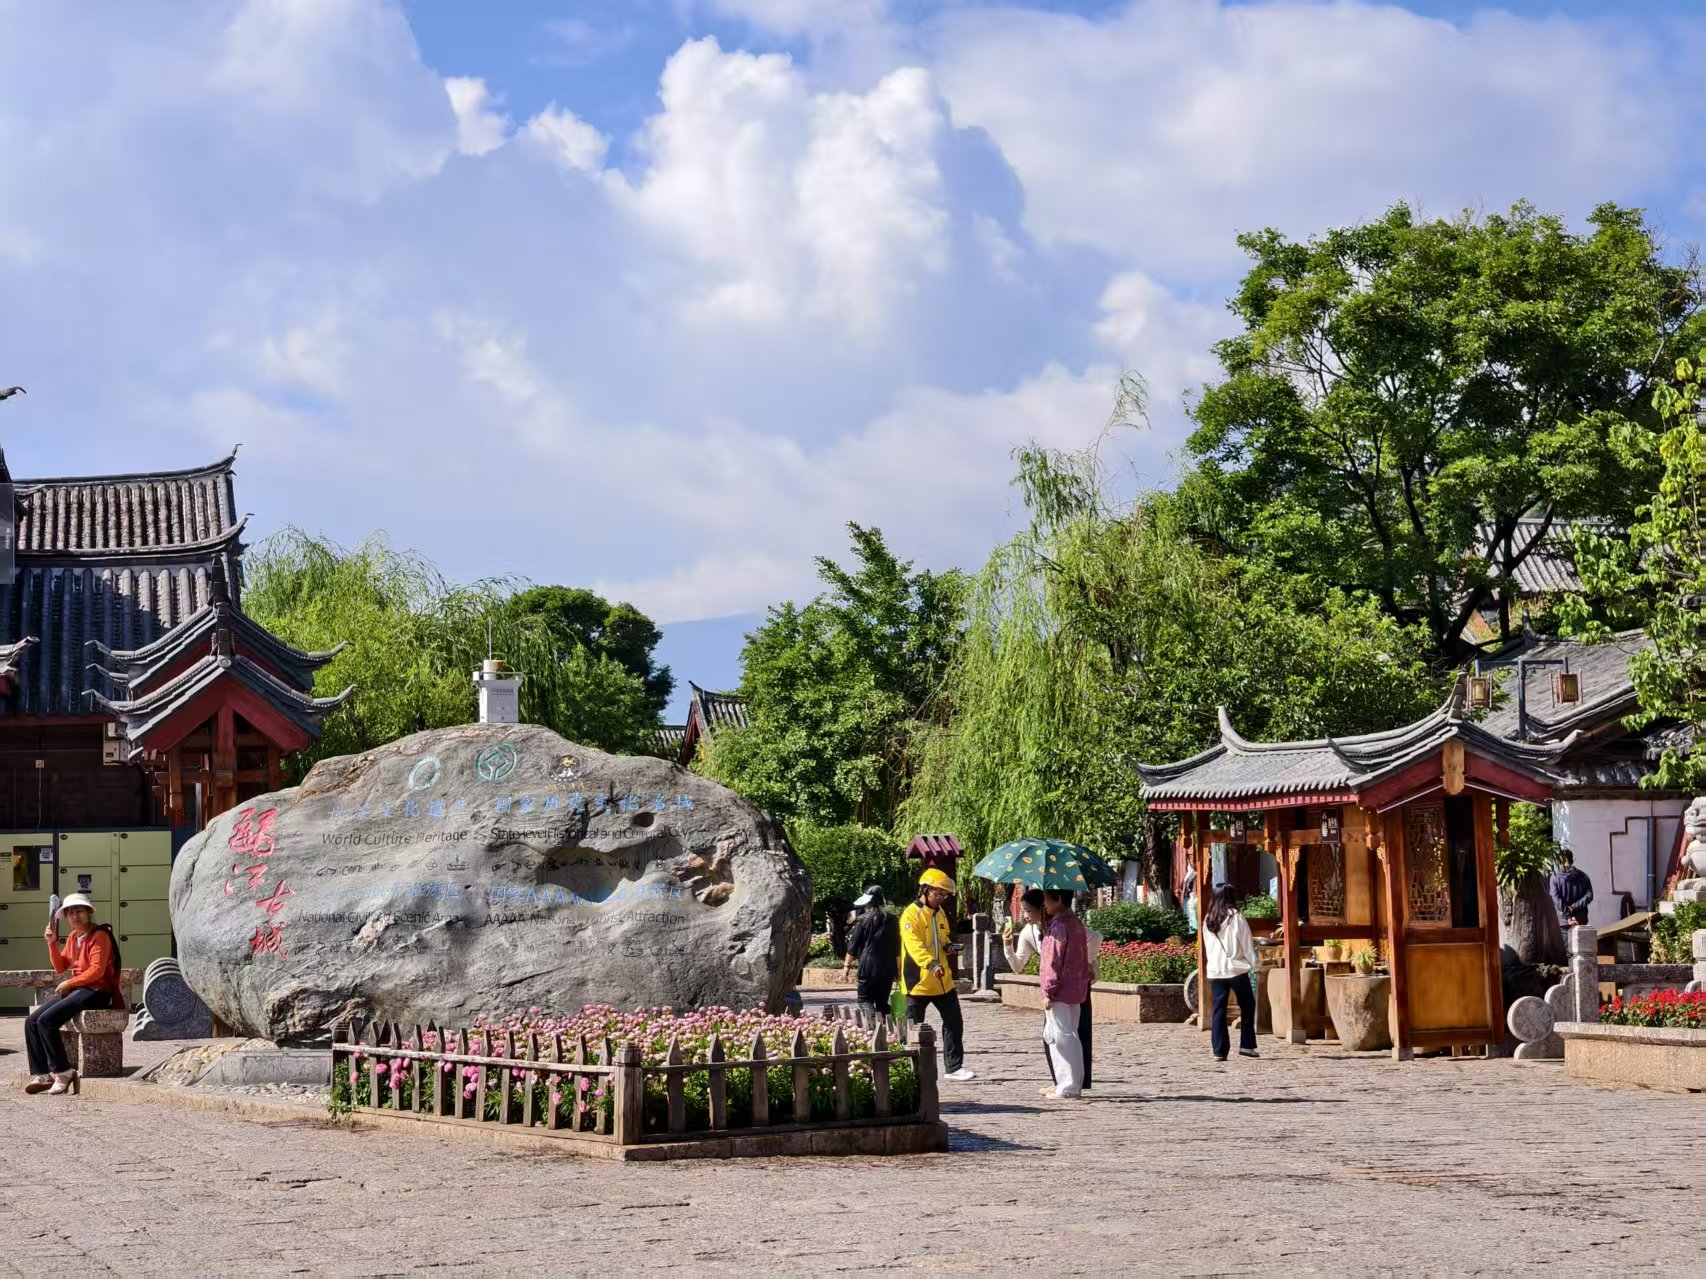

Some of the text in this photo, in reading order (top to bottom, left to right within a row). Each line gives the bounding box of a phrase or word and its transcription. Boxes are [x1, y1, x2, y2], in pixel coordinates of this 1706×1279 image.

[322, 829, 468, 846] World Culture Heritage
[600, 827, 622, 840] and
[298, 910, 348, 924] National
[394, 911, 431, 924] Scenic
[625, 909, 686, 925] Attraction
